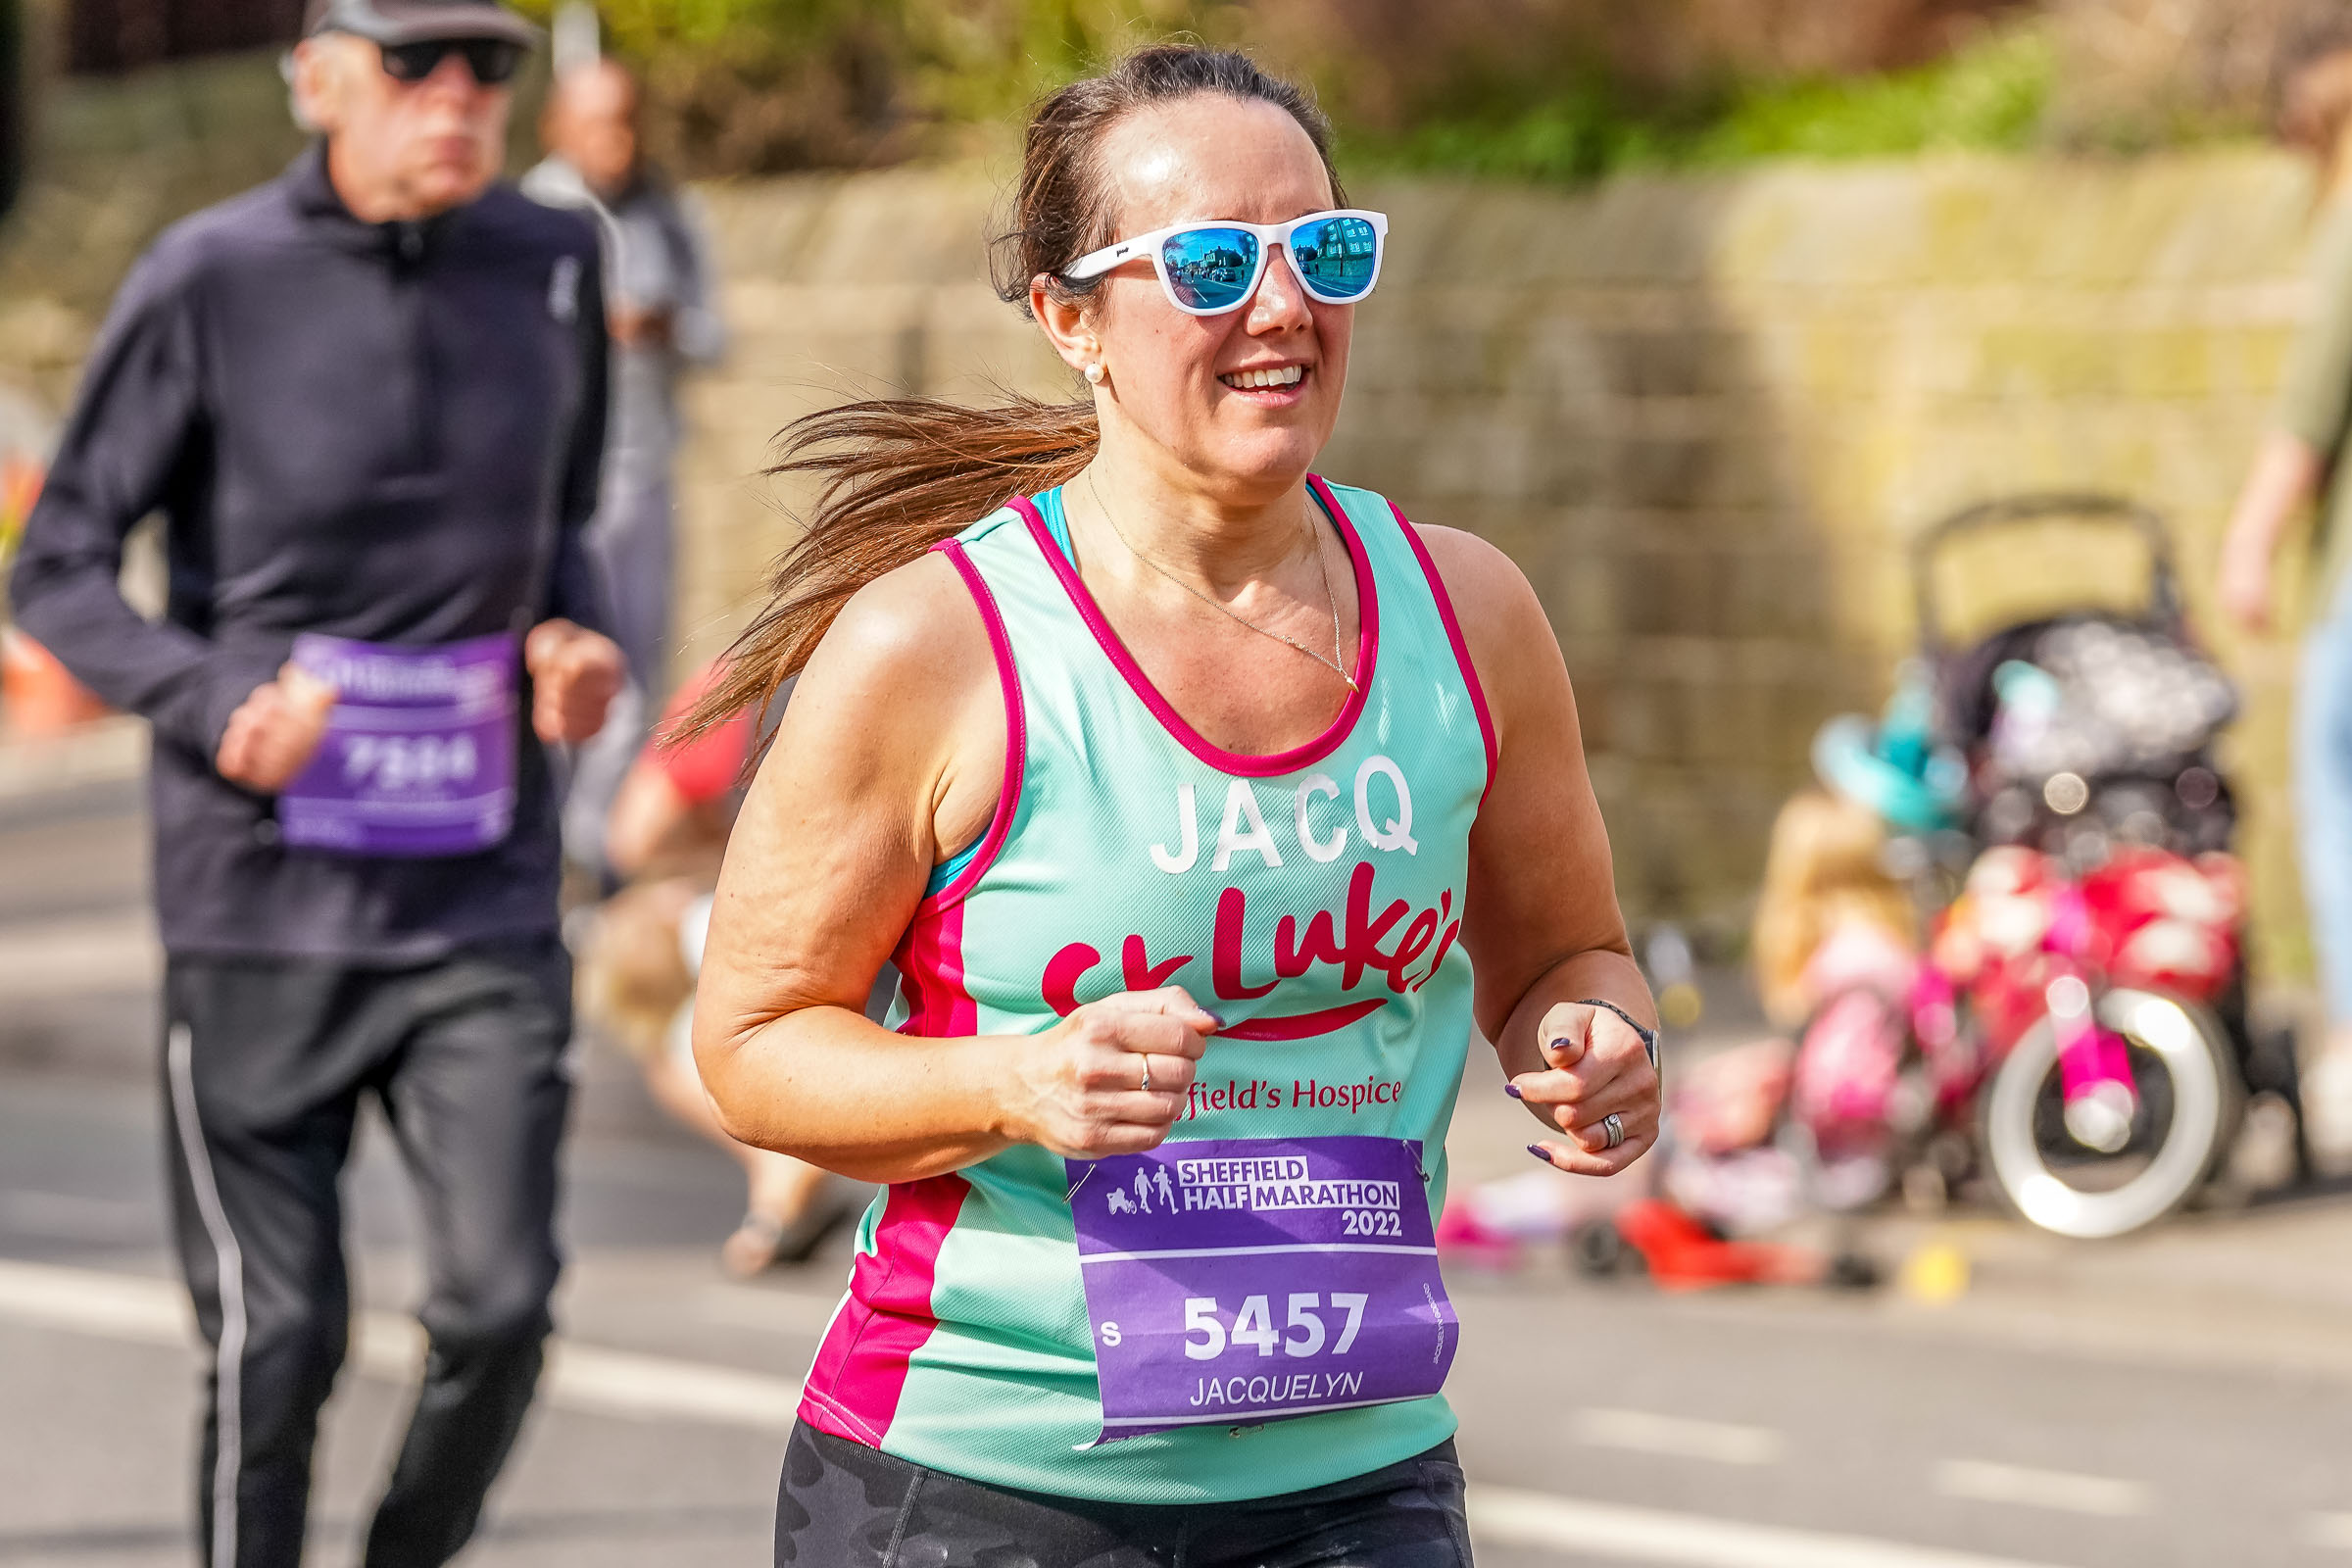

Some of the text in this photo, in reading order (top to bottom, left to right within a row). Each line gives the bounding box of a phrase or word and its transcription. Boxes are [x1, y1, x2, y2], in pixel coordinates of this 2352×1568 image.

[1150, 755, 1419, 874] JACQ
[1211, 861, 1460, 1001] Luke's
[1176, 1075, 1402, 1120] field's Hospice
[1181, 1159, 1305, 1184] SHEFFIELD
[1183, 1183, 1397, 1211] HALF MARATHON
[1342, 1209, 1402, 1237] 2022
[1100, 1321, 1122, 1348] S
[1183, 1292, 1370, 1361] 5457
[1190, 1371, 1364, 1407] JACQUELYN
